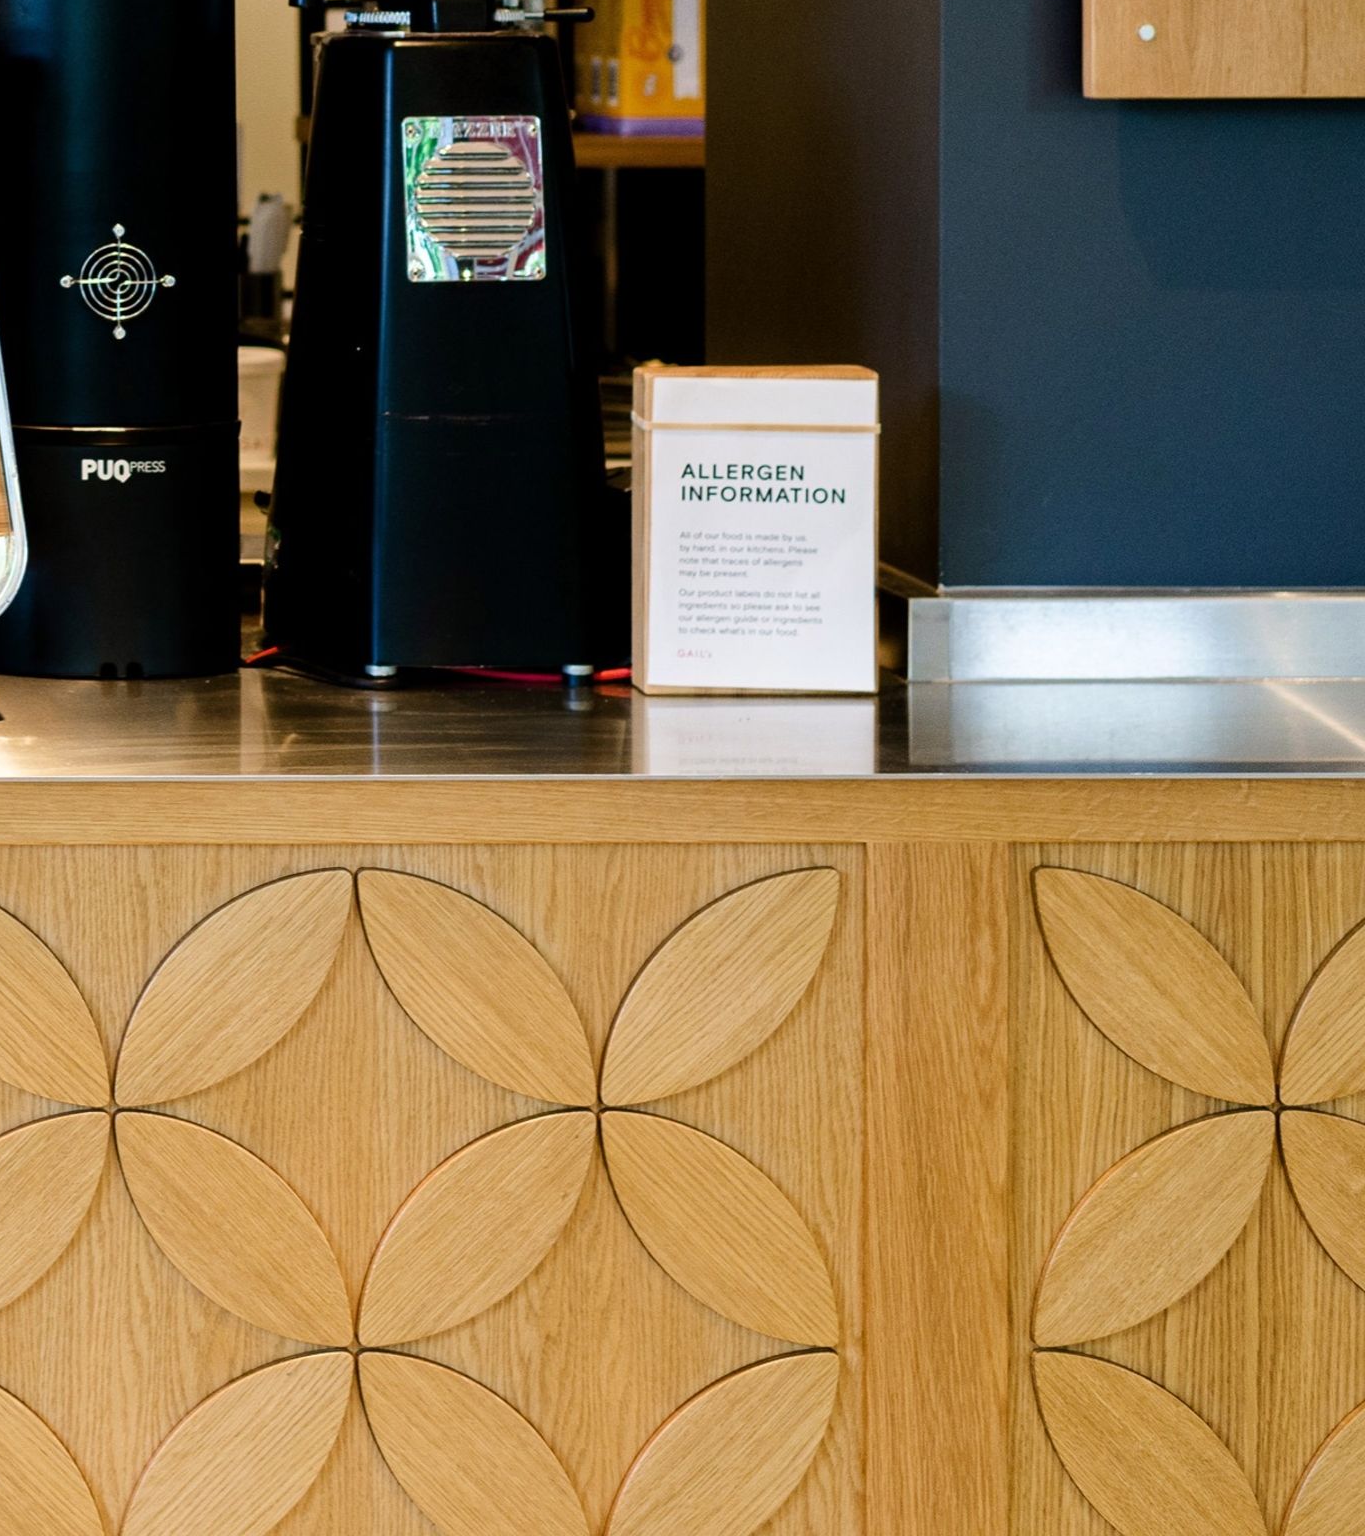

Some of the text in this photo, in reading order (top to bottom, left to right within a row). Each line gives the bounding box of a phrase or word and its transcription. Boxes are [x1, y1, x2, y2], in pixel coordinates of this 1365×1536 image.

[681, 463, 805, 481] ALLERGEN
[681, 485, 846, 504] INFORMATION
[721, 532, 743, 541] food
[754, 533, 780, 542] made
[788, 546, 818, 554] Please
[763, 558, 803, 568] allergens
[678, 588, 695, 597] Our
[697, 589, 733, 599] product
[678, 602, 728, 611] ingredients
[743, 603, 772, 612] please
[696, 614, 731, 624] allergen
[733, 615, 758, 625] guide
[772, 616, 823, 625] ingredients
